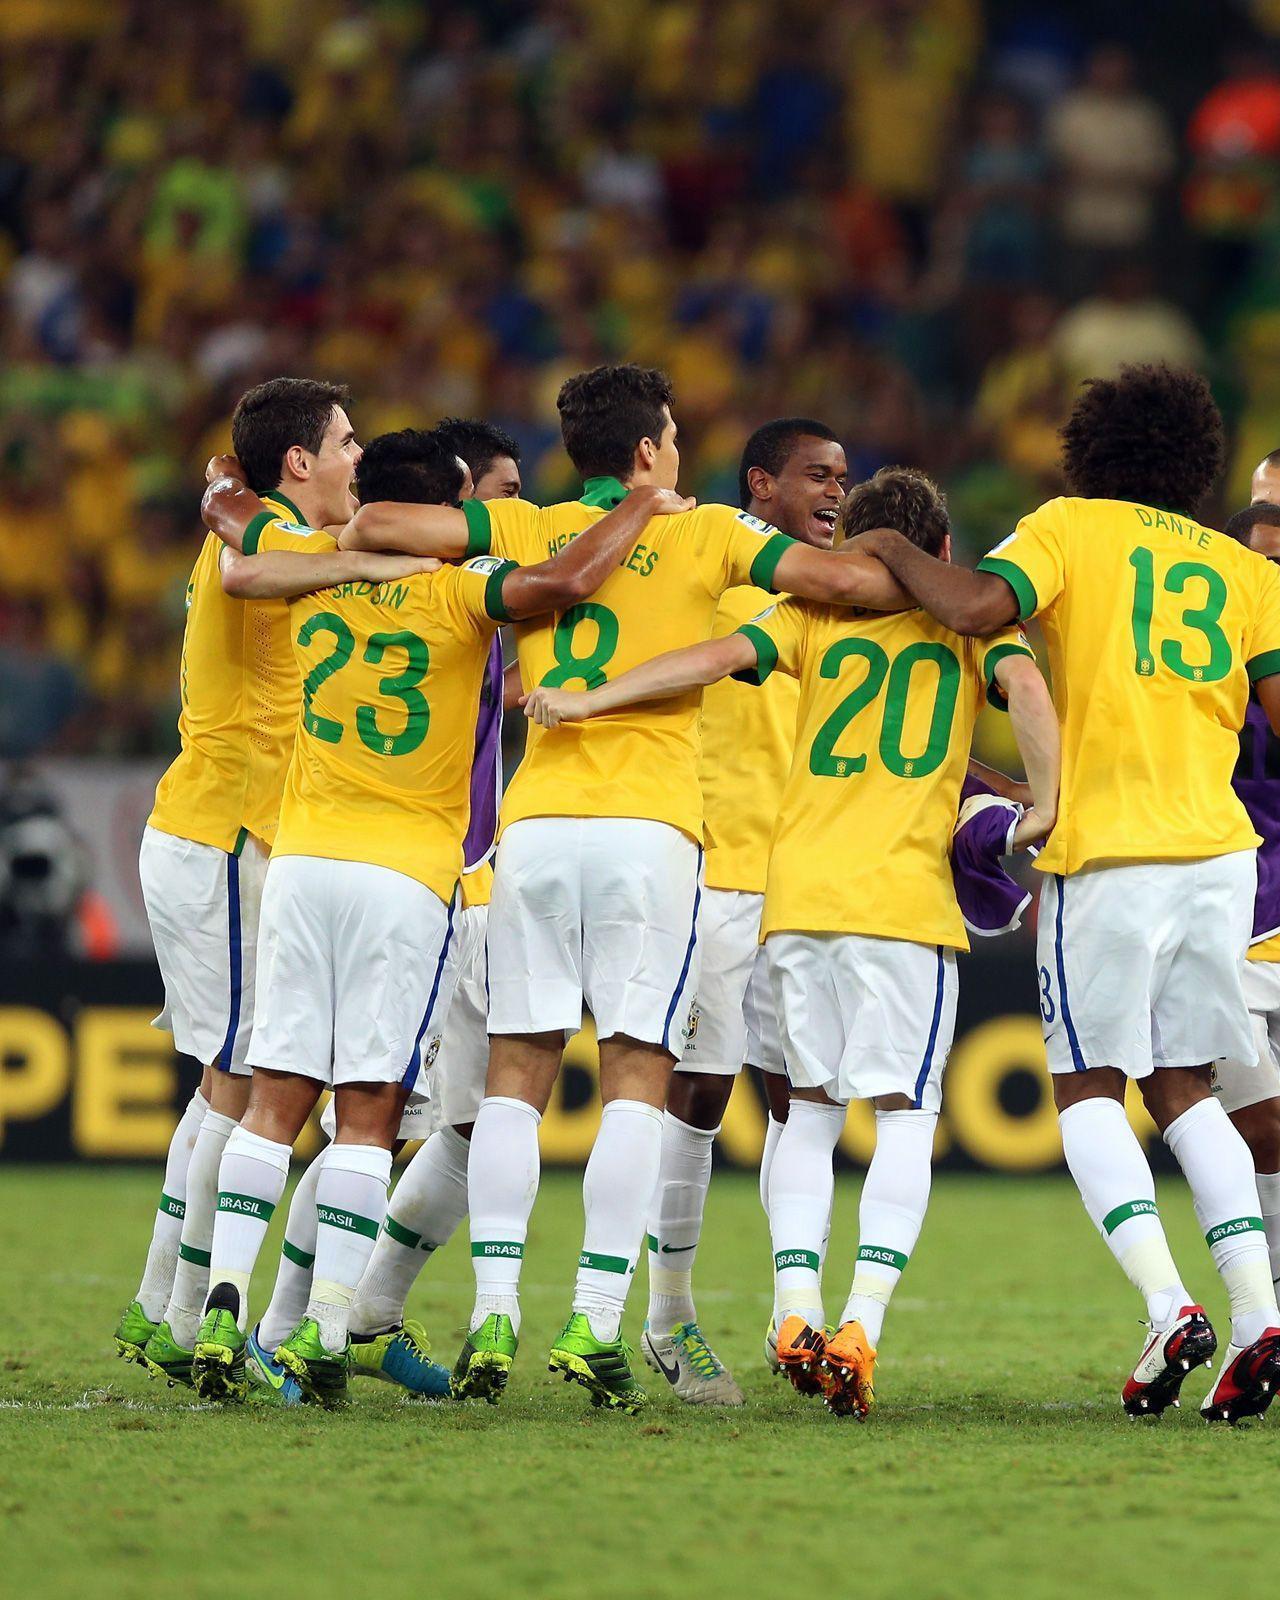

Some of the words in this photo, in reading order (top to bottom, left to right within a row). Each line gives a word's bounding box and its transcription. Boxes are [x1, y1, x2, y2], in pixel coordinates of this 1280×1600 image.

[1135, 508, 1212, 551] DANTE
[1128, 546, 1232, 683] 13
[540, 602, 619, 691] 8
[297, 611, 430, 757] 23
[809, 637, 960, 778] 20
[219, 1196, 262, 1215] BRASIL
[1211, 1219, 1254, 1240] BRASIL
[484, 1244, 522, 1257] BRASIL
[776, 1253, 810, 1268] BRASIL
[860, 1248, 896, 1264] BRASIL
